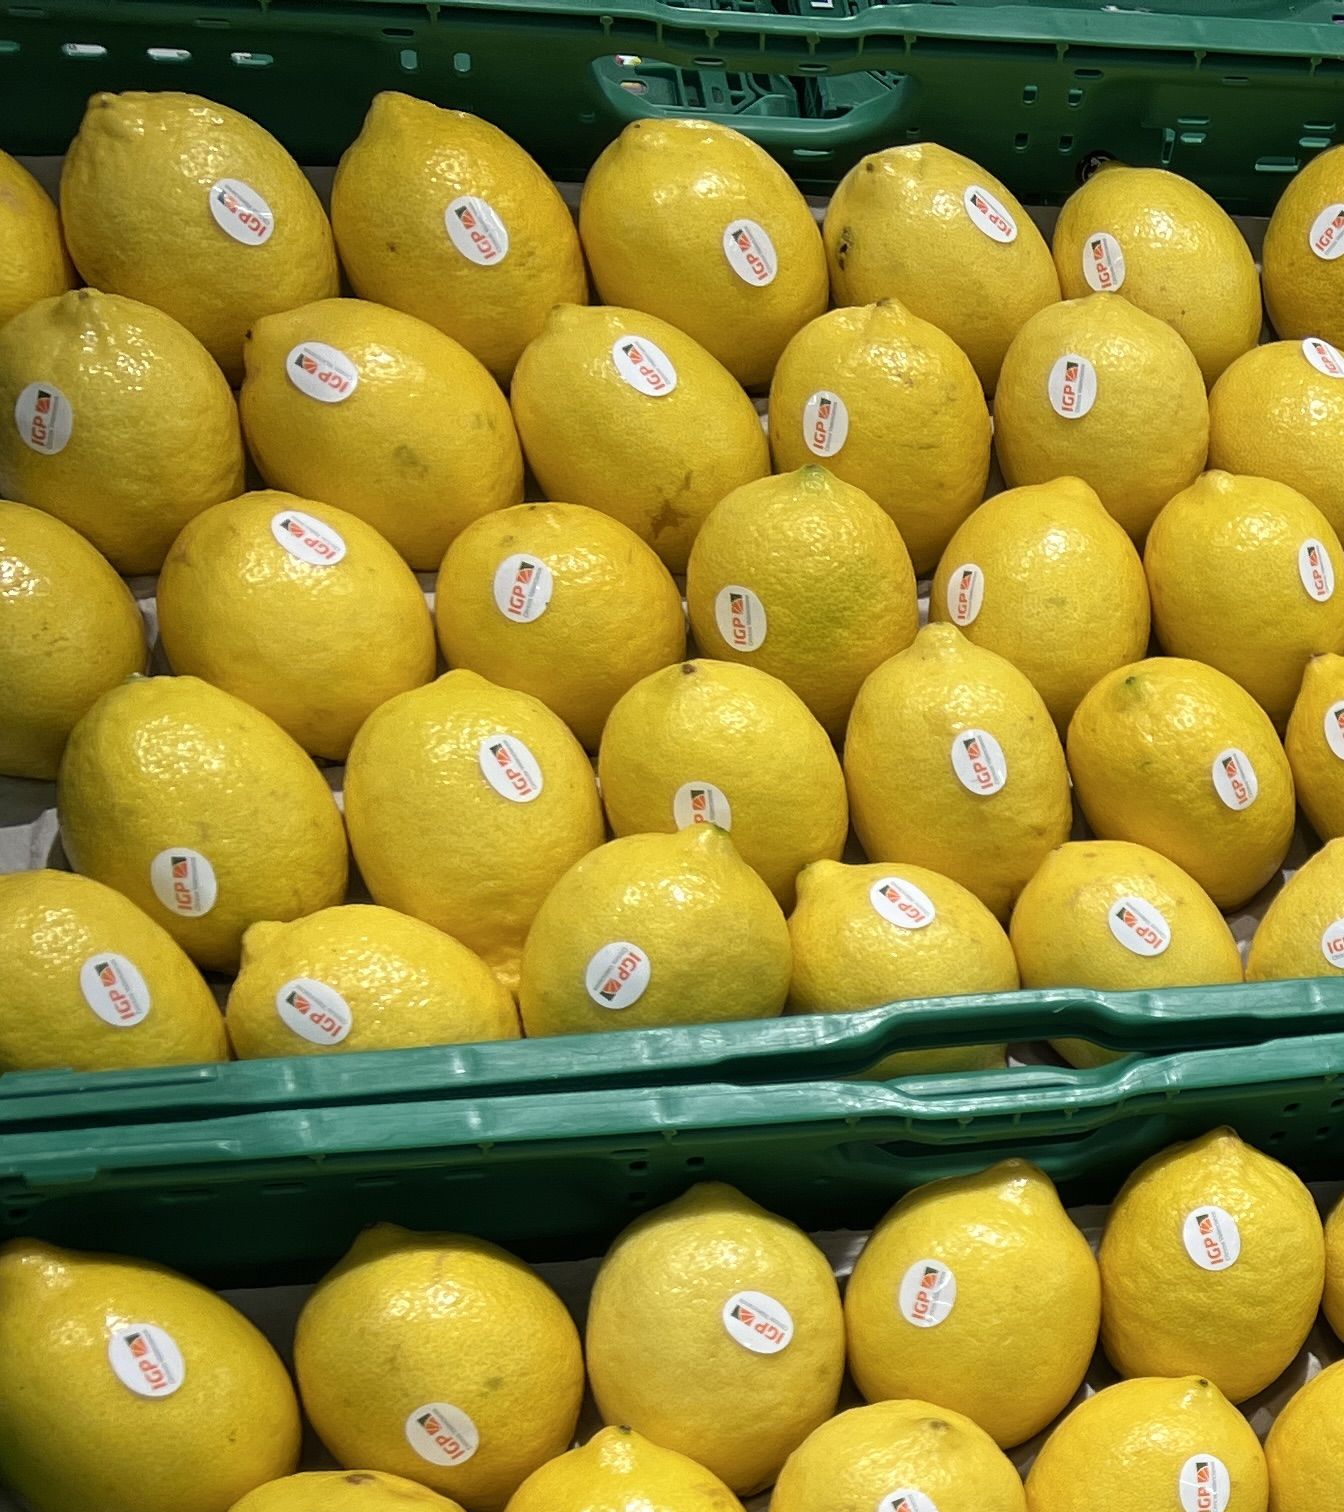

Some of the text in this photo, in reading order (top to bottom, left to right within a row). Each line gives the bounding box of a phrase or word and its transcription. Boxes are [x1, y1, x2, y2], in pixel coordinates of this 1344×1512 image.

[471, 231, 497, 260] IGP
[1316, 227, 1335, 252] IGP
[746, 253, 769, 281] IGP
[318, 371, 350, 393] IGP
[813, 421, 827, 450] IGP
[509, 585, 525, 615] IGP
[505, 769, 532, 797] IGP
[1136, 927, 1164, 950] IGP
[618, 952, 643, 982] IGP
[755, 1322, 786, 1345] IGP
[139, 1360, 168, 1391] IGP
